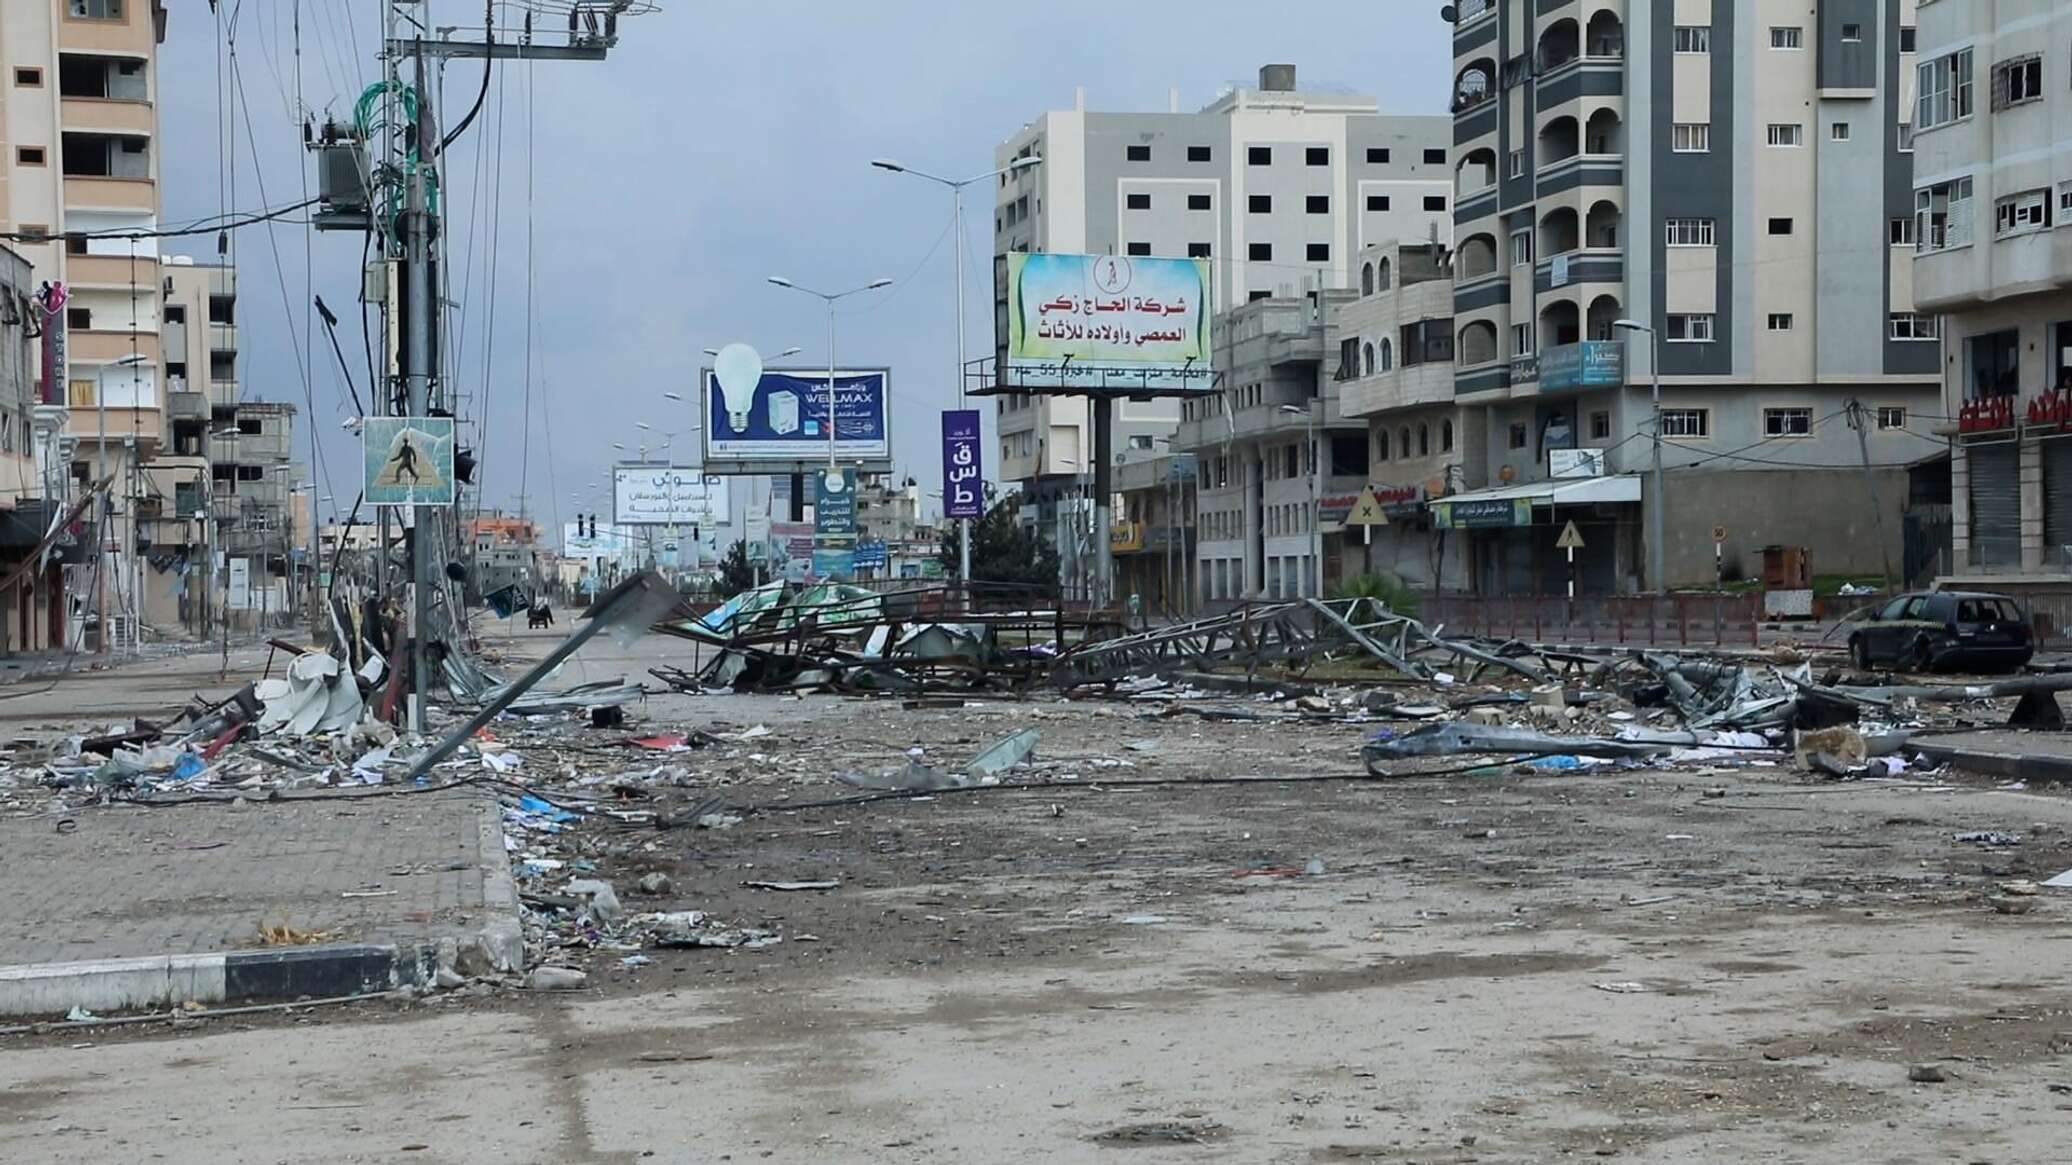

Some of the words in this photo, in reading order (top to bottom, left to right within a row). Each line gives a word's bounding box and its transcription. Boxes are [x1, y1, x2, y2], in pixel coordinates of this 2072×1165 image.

[1038, 294, 1079, 315] زكي
[1083, 297, 1130, 315] الحاج
[1134, 296, 1186, 317] شركة
[1134, 327, 1186, 347] العمصي
